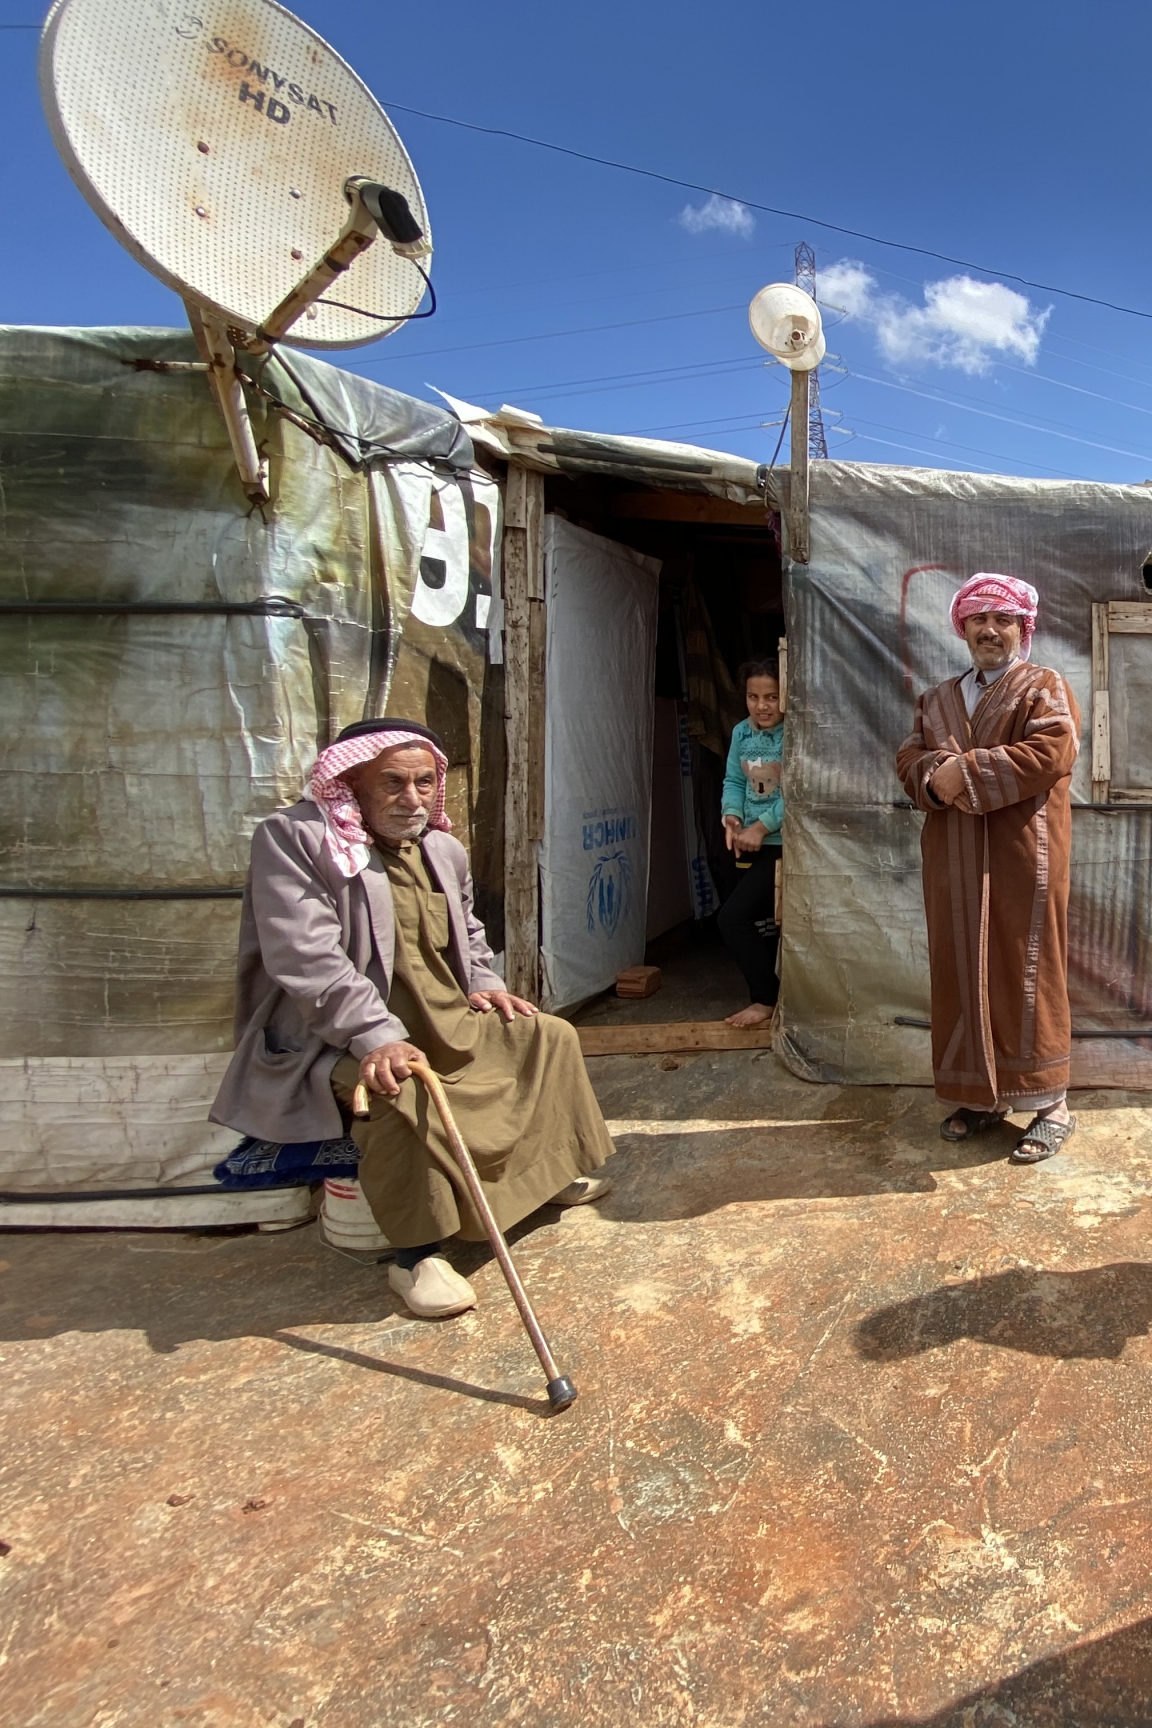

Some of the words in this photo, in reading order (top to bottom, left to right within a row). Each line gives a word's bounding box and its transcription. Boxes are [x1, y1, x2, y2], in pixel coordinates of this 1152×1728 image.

[205, 37, 338, 126] SONYSAT
[238, 80, 291, 125] HD
[582, 815, 637, 851] UNHCR
